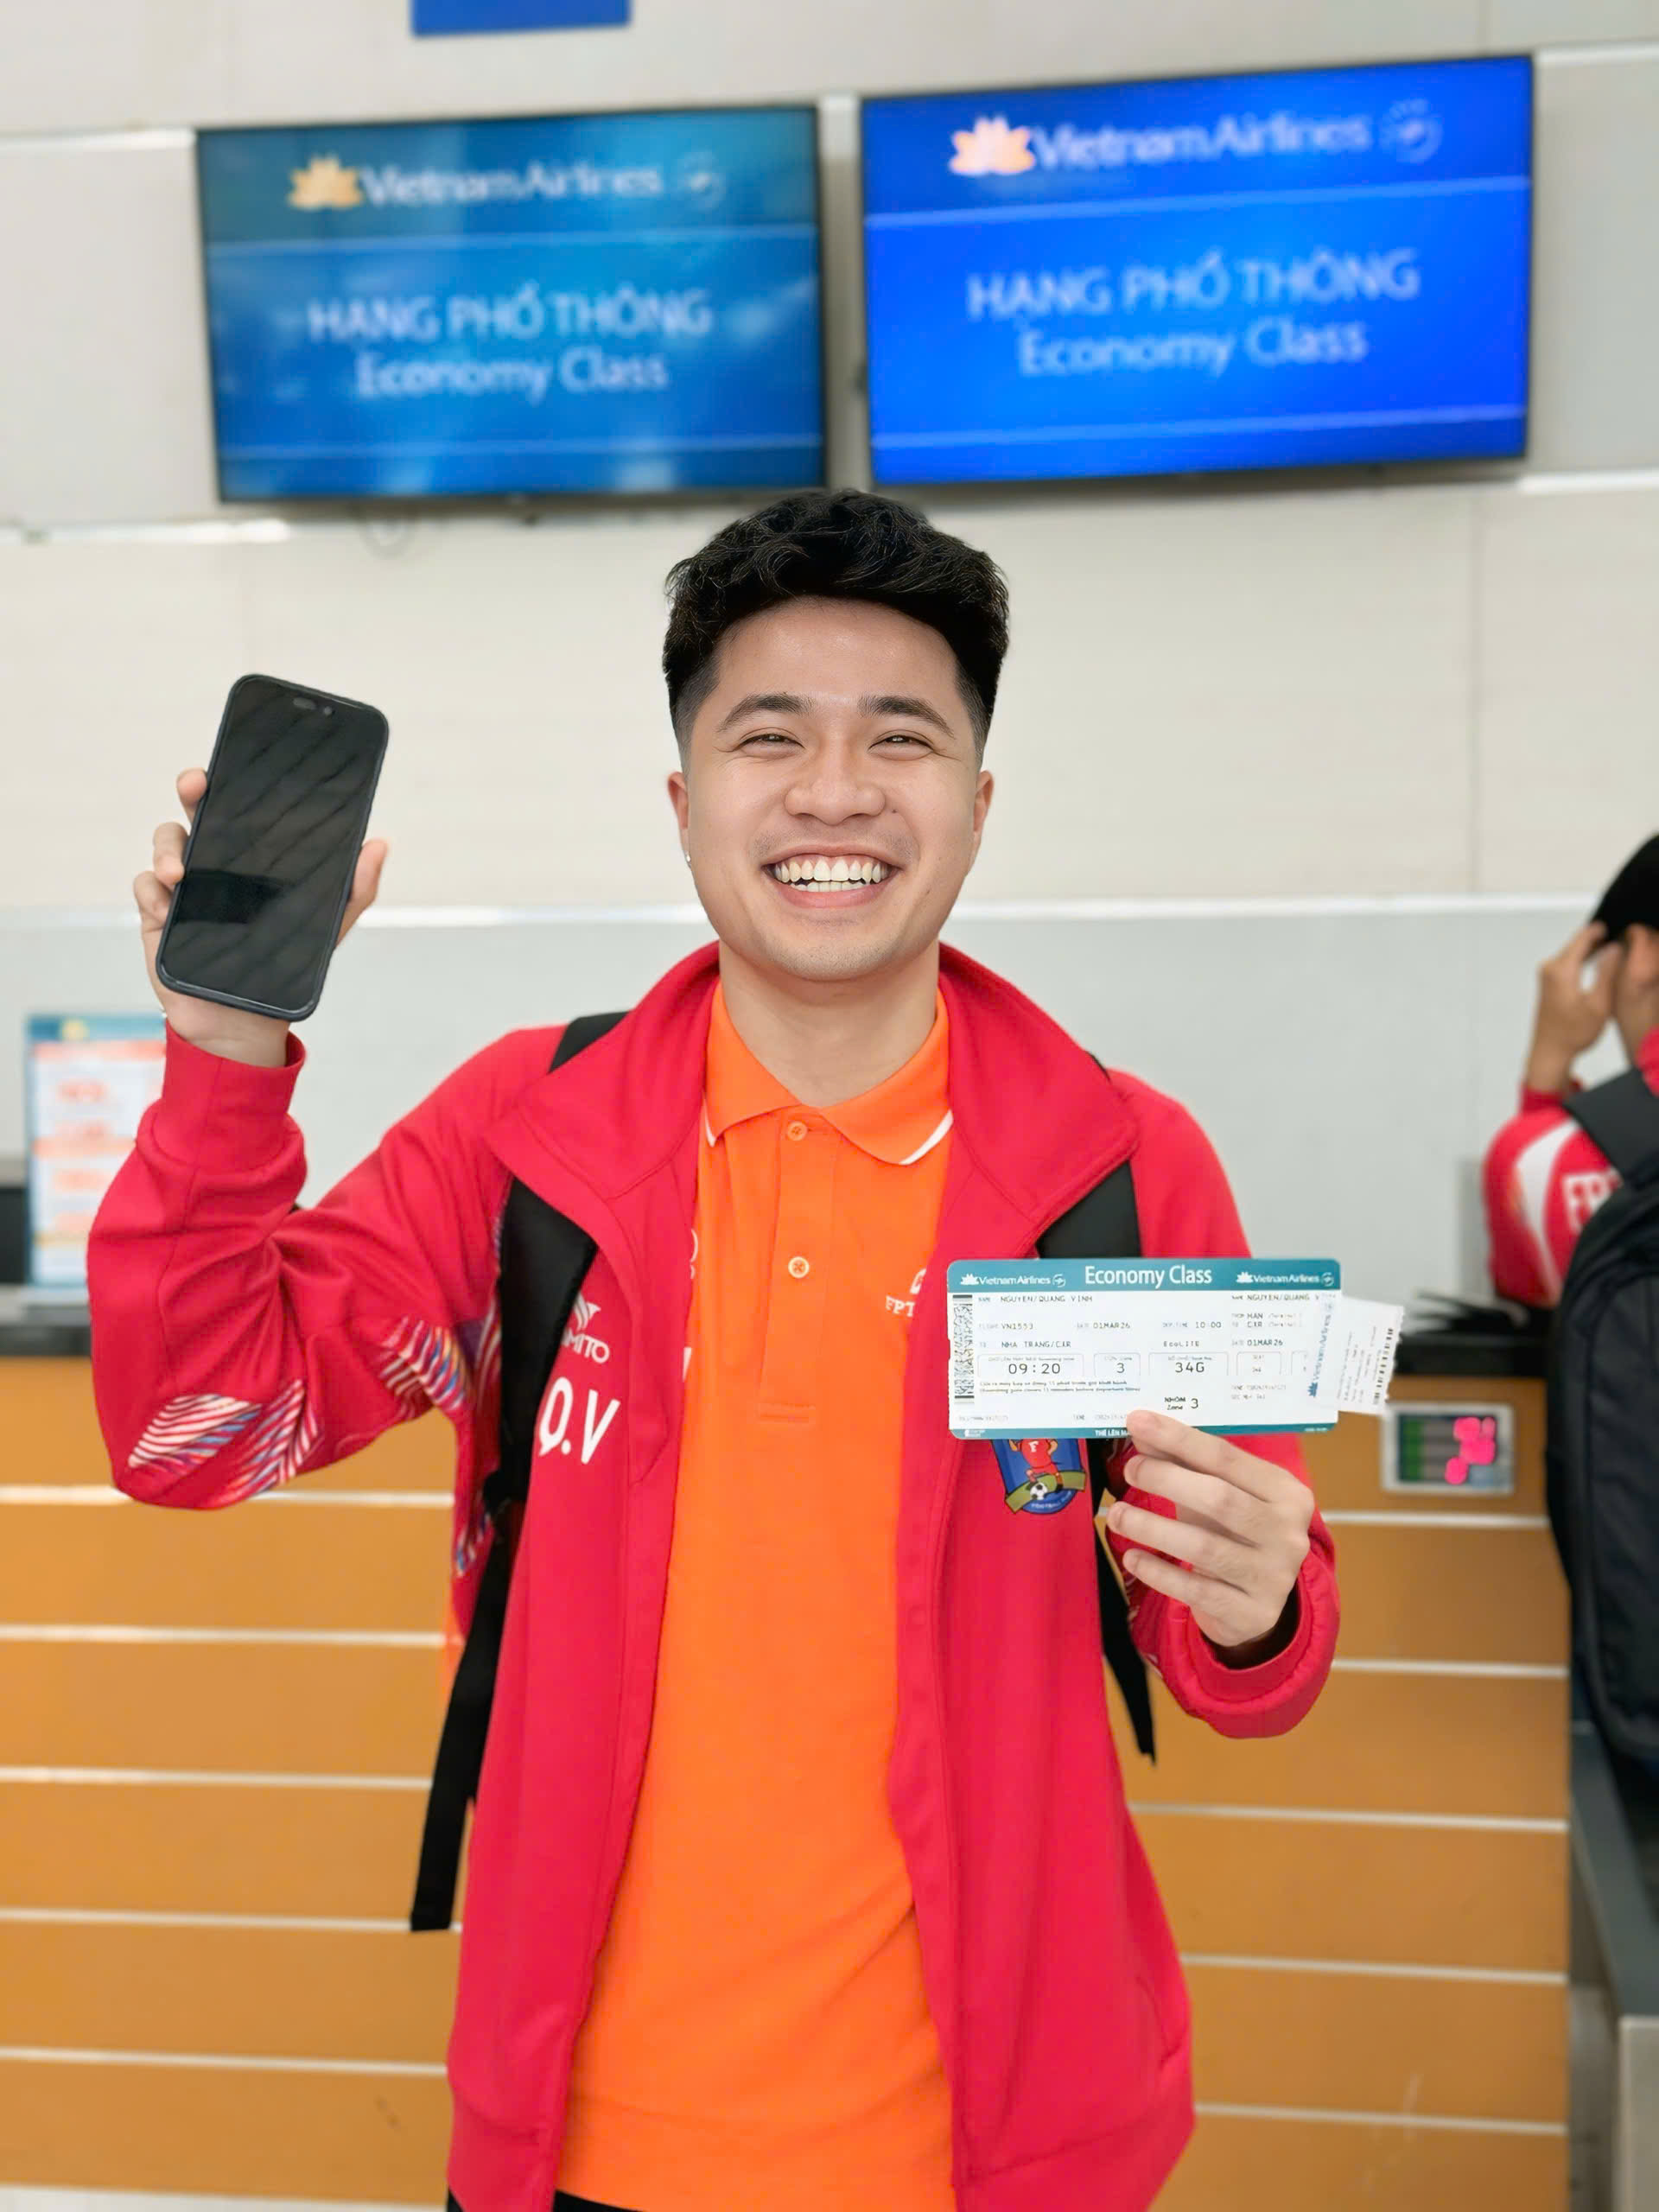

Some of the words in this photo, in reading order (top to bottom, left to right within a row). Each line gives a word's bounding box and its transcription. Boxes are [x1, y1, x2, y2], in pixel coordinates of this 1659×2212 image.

[1241, 246, 1420, 306] THÔNG
[556, 283, 713, 340] THÔNG
[1020, 330, 1233, 378] Economy
[1246, 317, 1368, 366] Class
[356, 353, 550, 404] Economy
[561, 346, 669, 393] Class
[1084, 1266, 1165, 1288] Economy
[1169, 1264, 1212, 1284] Class
[886, 1295, 915, 1317] FPT
[562, 1327, 610, 1364] MITO
[1008, 1363, 1061, 1375] 09:20
[1116, 1363, 1125, 1374] 3
[1175, 1362, 1205, 1373] 34G
[1191, 1398, 1199, 1409] 3
